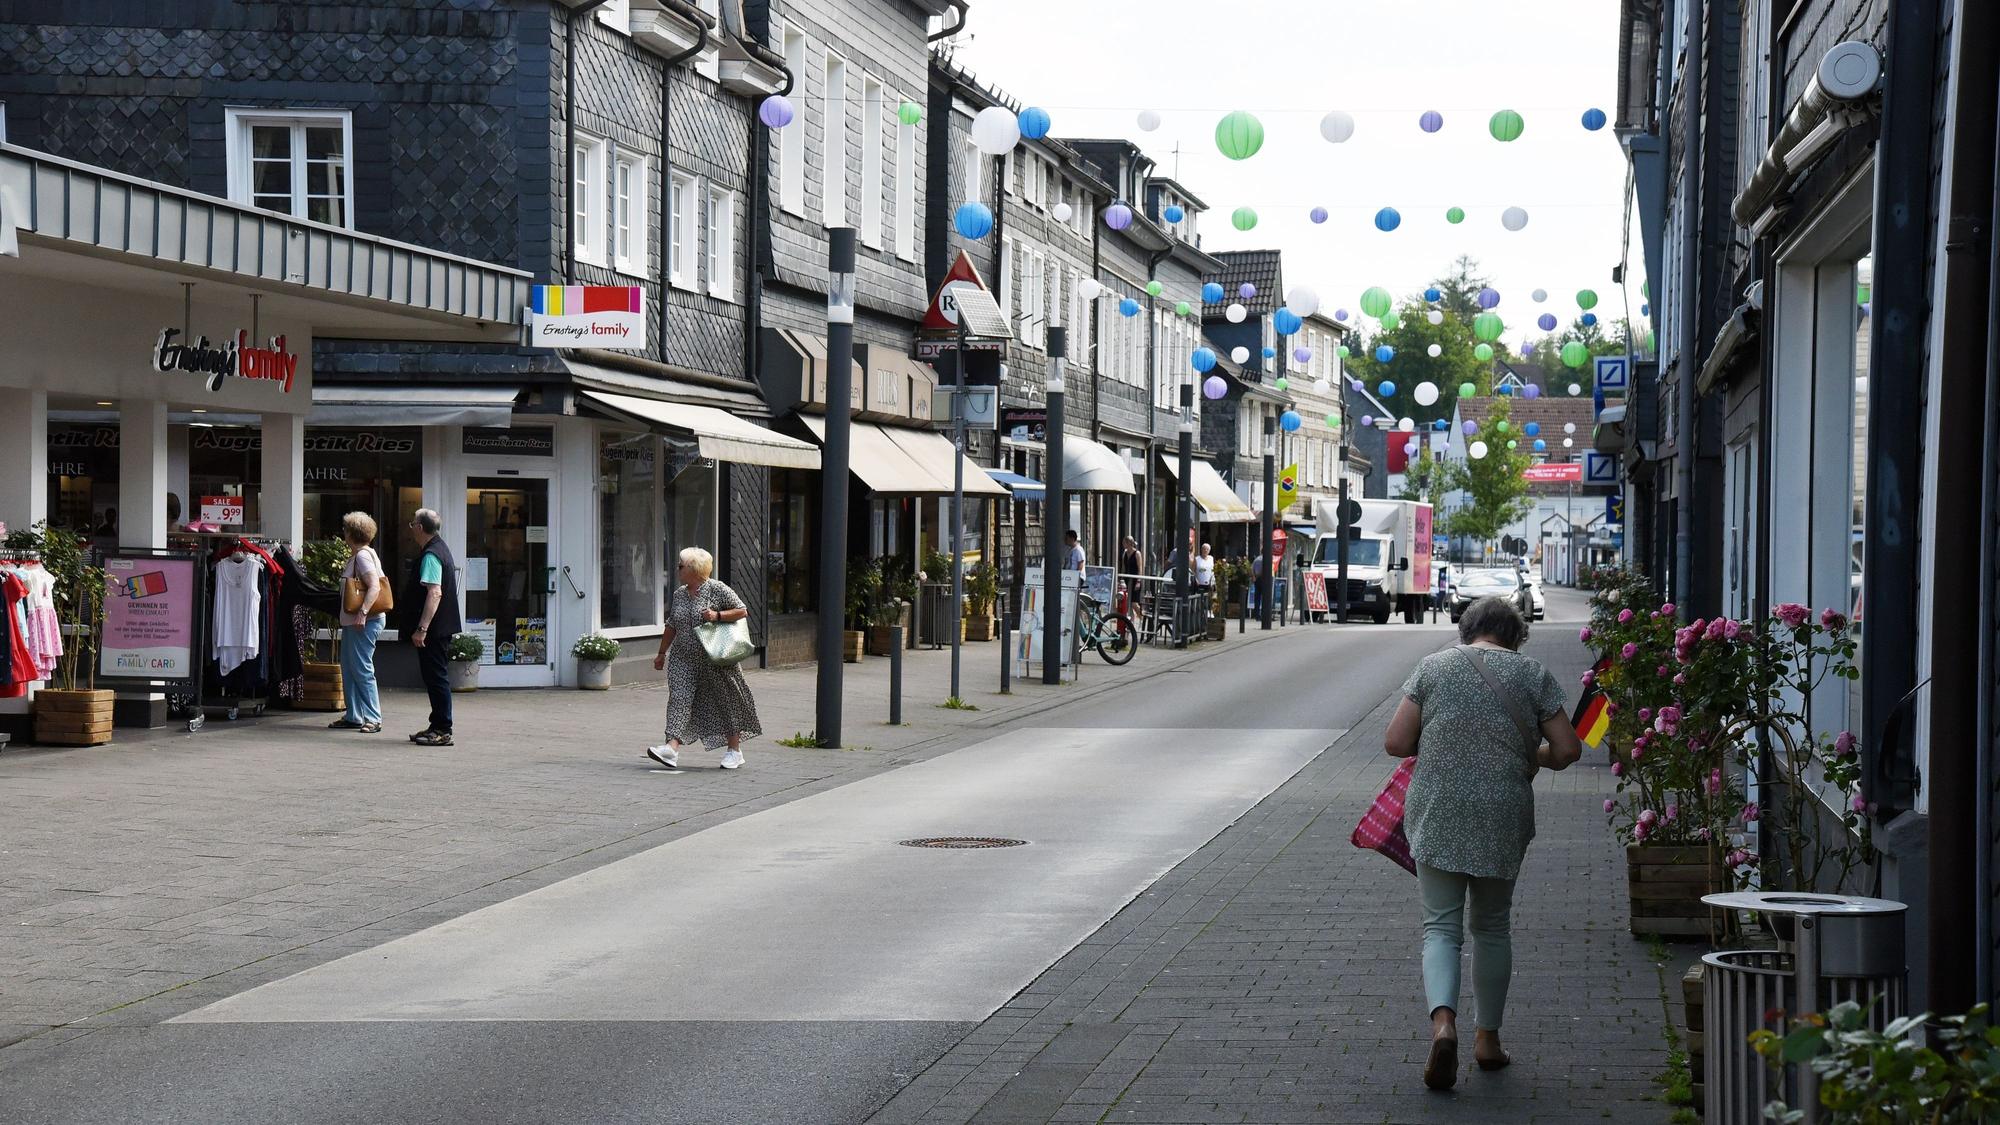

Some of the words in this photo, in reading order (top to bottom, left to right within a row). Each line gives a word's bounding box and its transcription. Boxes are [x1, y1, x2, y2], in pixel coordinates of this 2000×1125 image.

[543, 323, 589, 339] Ernsting's
[591, 322, 630, 338] family
[154, 327, 237, 392] Ernsting's
[235, 328, 298, 393] family
[356, 433, 414, 452] Ries
[304, 467, 348, 480] AHRE
[213, 498, 231, 506] SALE
[117, 658, 147, 668] FAMILY
[151, 658, 175, 669] CARD
